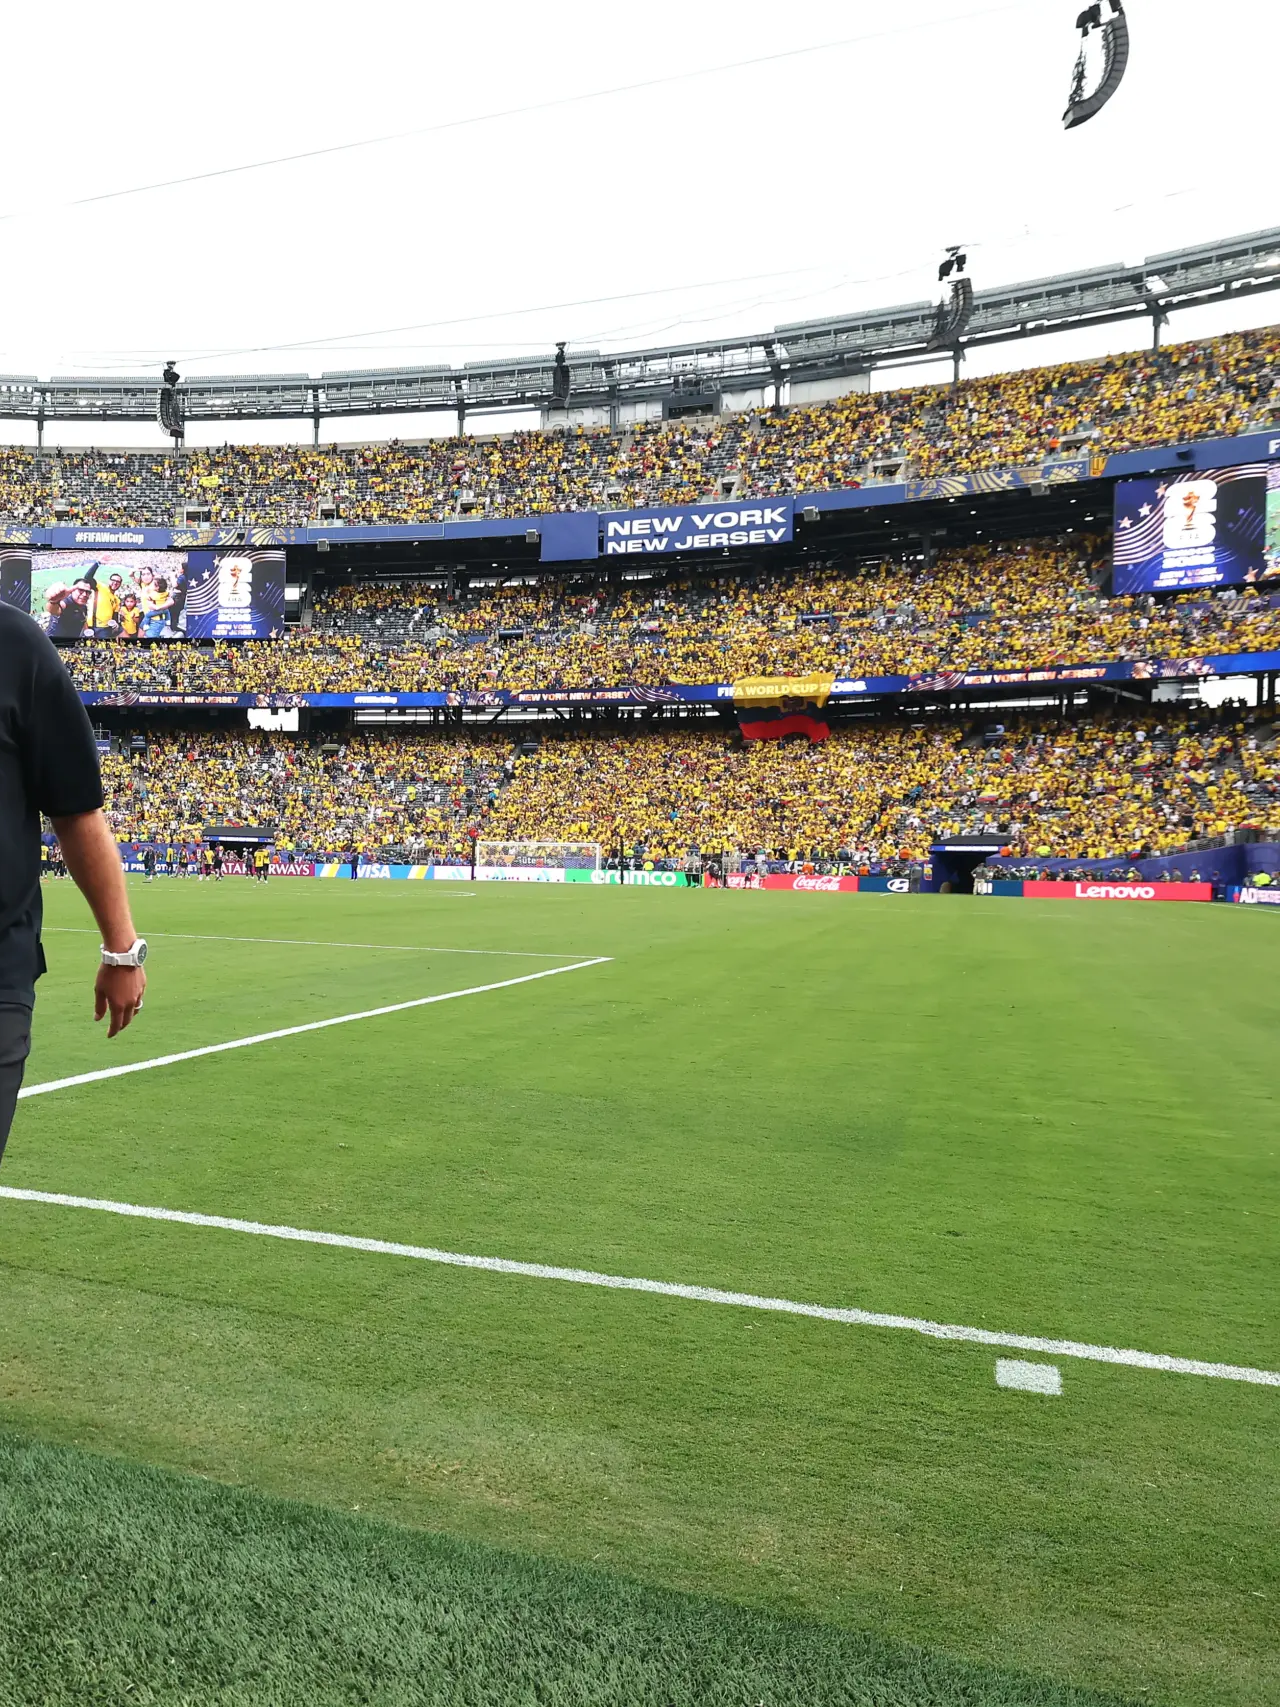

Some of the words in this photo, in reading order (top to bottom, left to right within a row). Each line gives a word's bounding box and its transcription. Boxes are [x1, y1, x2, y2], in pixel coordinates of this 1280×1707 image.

[607, 516, 683, 537] NEW
[690, 506, 787, 530] YORK
[75, 531, 145, 545] #FIFAWorldCup
[607, 537, 669, 554] NEW
[674, 527, 787, 549] JERSEY
[964, 675, 993, 685] NEW
[993, 673, 1027, 683] YORK
[1028, 671, 1057, 681] NEW
[1057, 668, 1106, 680] JERSEY
[518, 693, 541, 701] NEW
[541, 692, 569, 701] YORK
[569, 692, 592, 700] NEW
[592, 691, 630, 700] JERSEY
[717, 685, 744, 697] FIFA
[744, 684, 790, 696] WORLD
[791, 683, 818, 694] CUP
[138, 695, 160, 703] NEW
[160, 696, 183, 704] YORK
[184, 696, 205, 704] NEW
[205, 696, 238, 704] JERSEY
[356, 864, 390, 878] VISA
[590, 869, 676, 886] aramco
[793, 876, 842, 891] Coca-Cola
[1075, 883, 1155, 899] Lenovo
